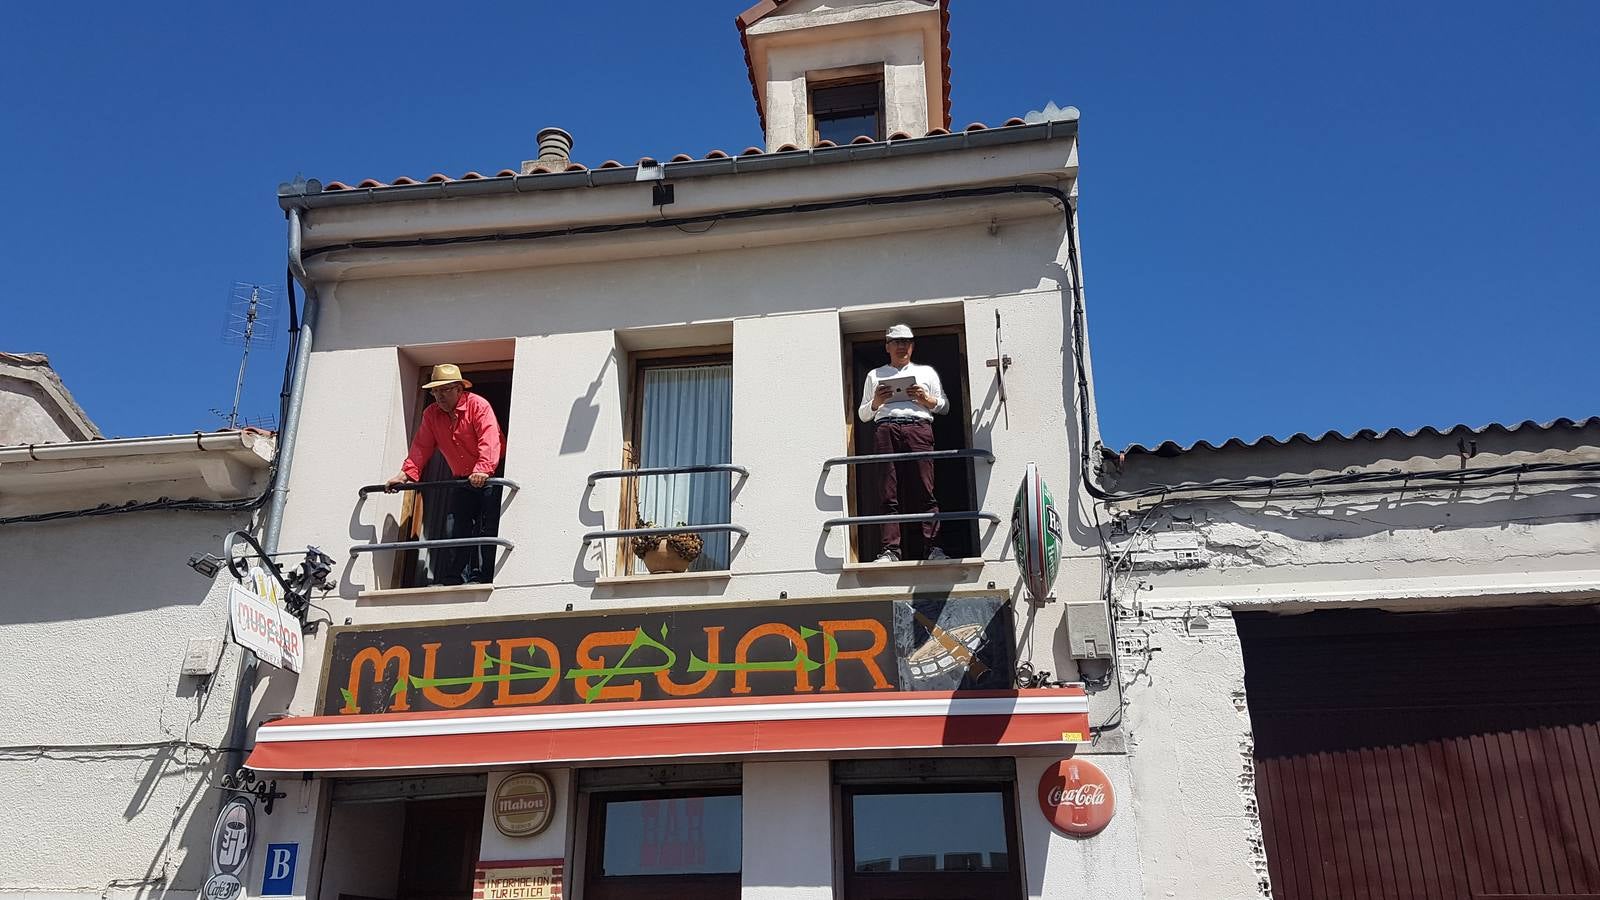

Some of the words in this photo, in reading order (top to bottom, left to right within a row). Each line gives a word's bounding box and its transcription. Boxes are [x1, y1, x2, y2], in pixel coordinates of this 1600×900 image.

[339, 619, 895, 714] MUDEJAR
[1048, 783, 1105, 807] Coca-Cola
[269, 848, 291, 880] B
[487, 876, 550, 888] INFORMACION
[491, 887, 543, 899] TURISTICA
